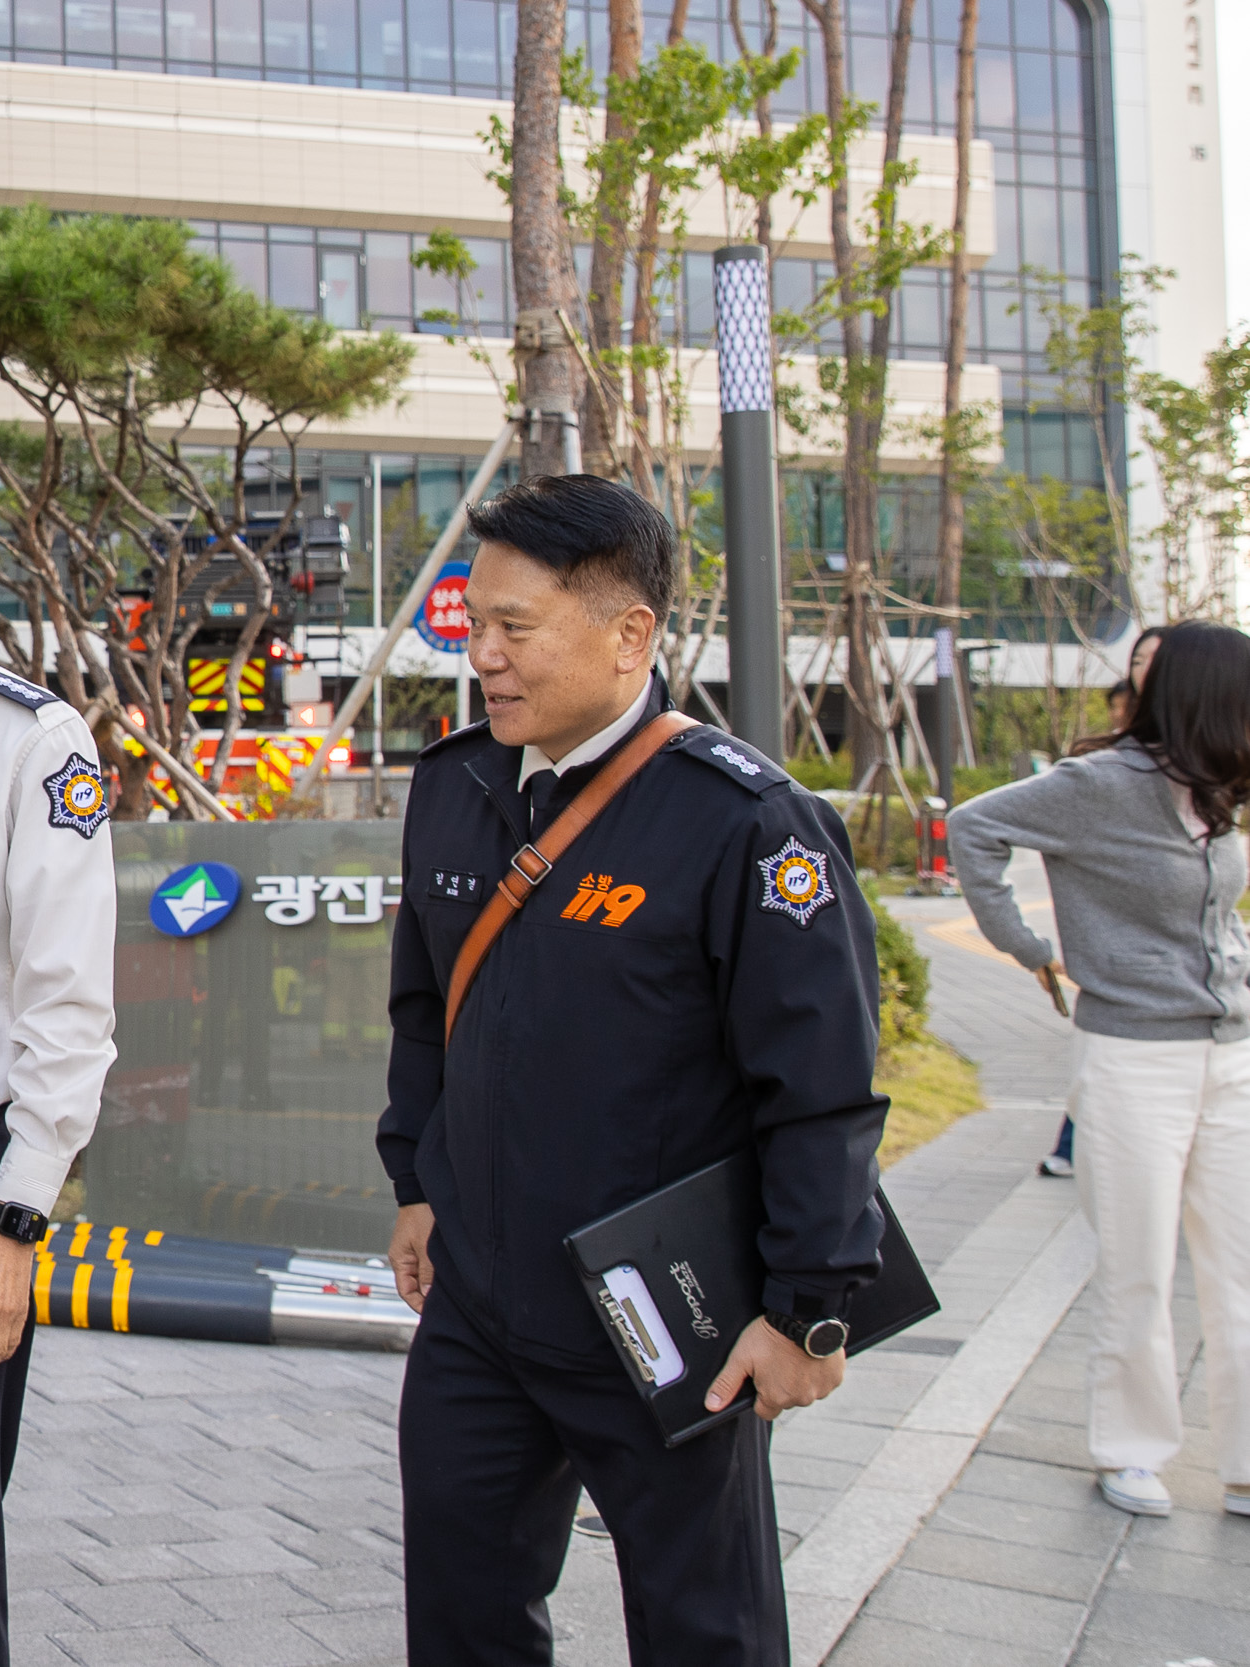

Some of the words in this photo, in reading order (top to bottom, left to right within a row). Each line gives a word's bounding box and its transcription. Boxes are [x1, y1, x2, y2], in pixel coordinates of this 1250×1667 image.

[431, 587, 463, 608] 상수
[74, 787, 93, 803] 119
[579, 872, 614, 892] 소방
[787, 872, 808, 887] 119
[560, 884, 646, 928] 119
[669, 1261, 719, 1339] Report
